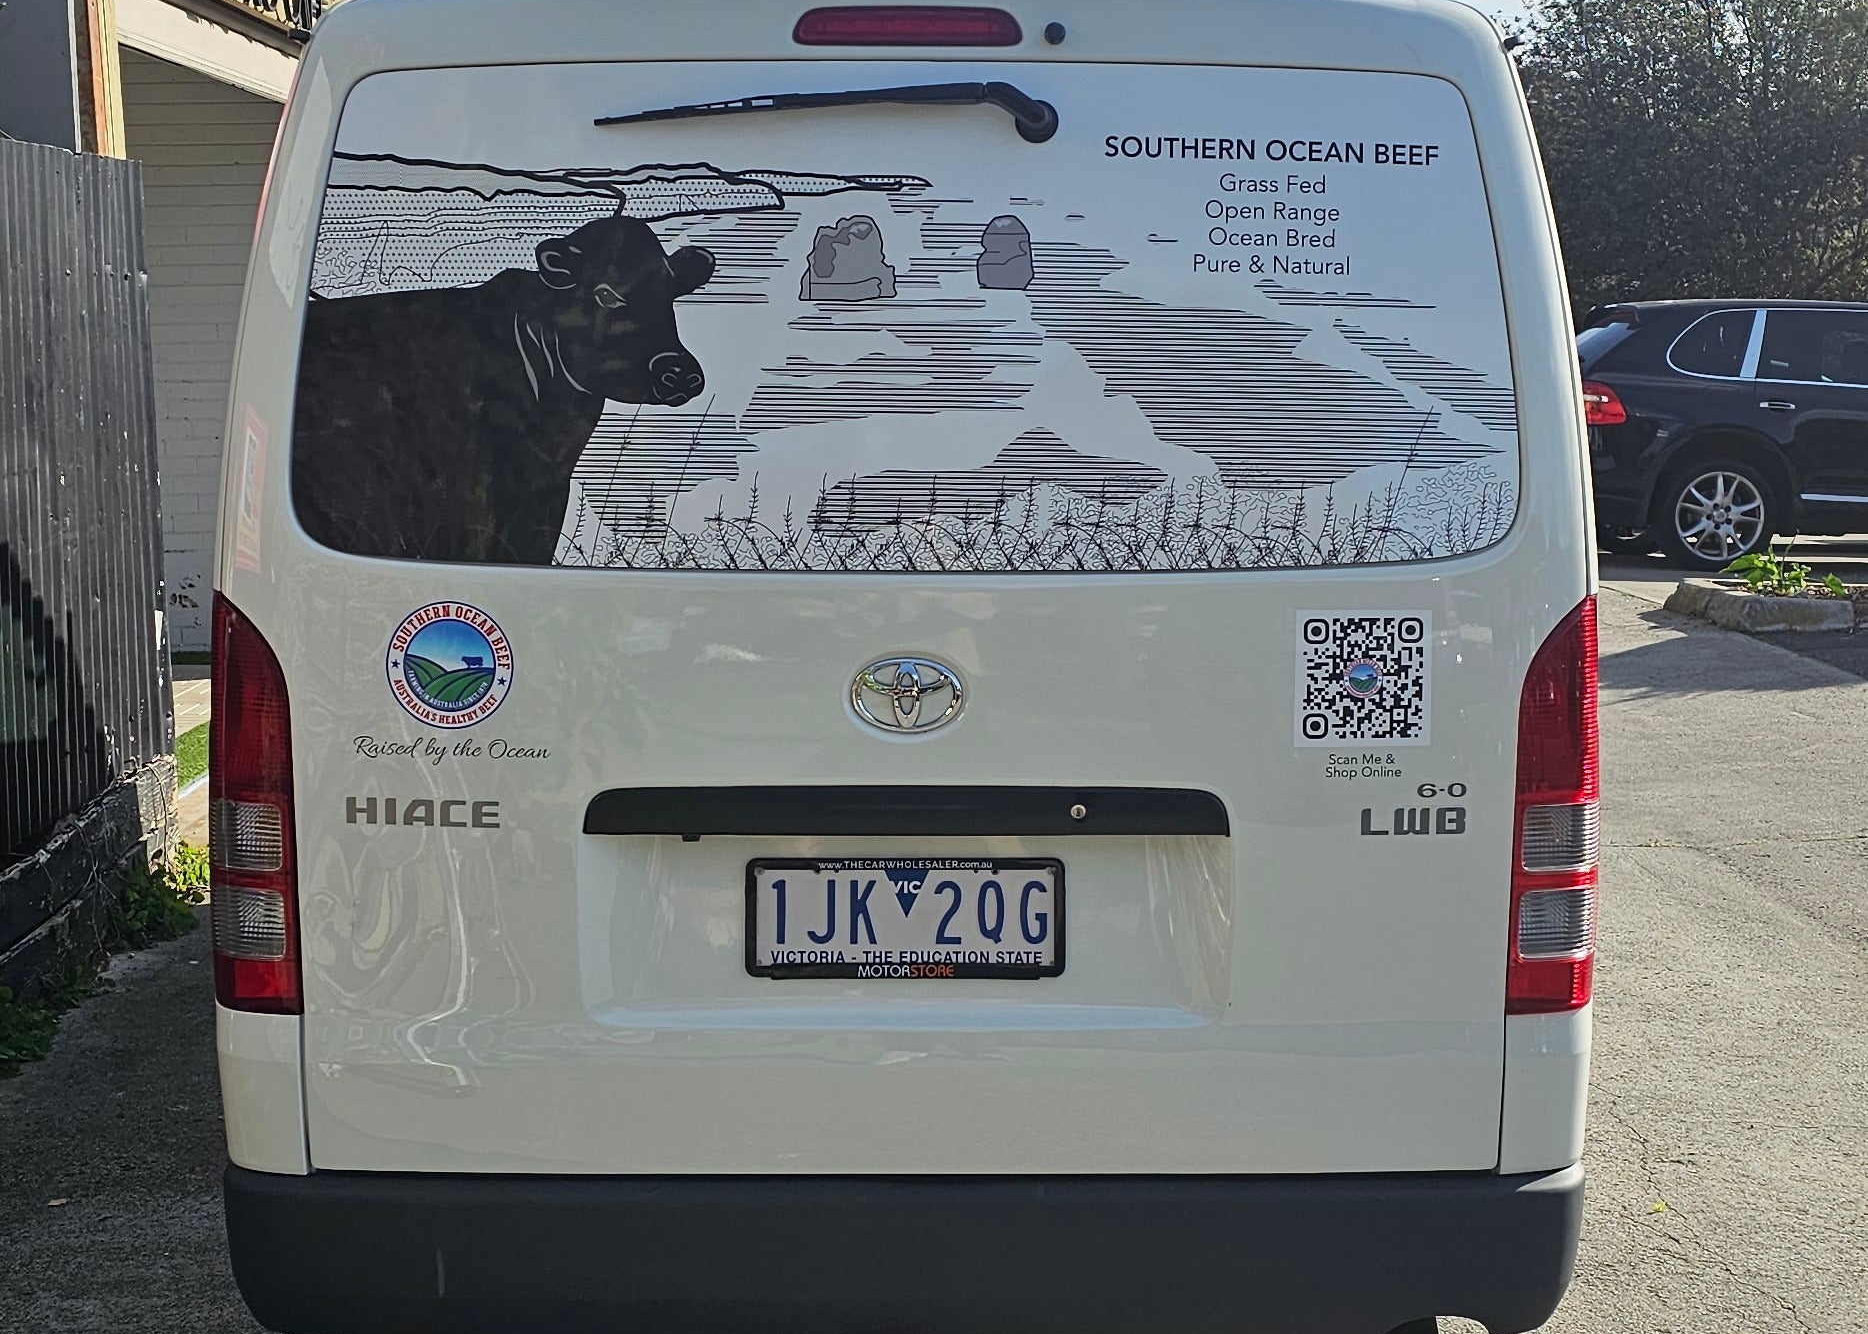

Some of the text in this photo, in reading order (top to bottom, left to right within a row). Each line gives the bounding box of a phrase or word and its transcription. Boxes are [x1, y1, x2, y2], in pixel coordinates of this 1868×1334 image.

[1104, 135, 1440, 166] SOUTHERN OCEAN BEEF
[1220, 173, 1326, 194] Grass Fed
[1205, 200, 1340, 226] Open Range
[1208, 227, 1335, 248] Ocean Bred
[1194, 254, 1350, 276] Pure & Natural
[393, 605, 510, 670] SOUTHERN OCEAN BEEF
[394, 680, 498, 724] AUSTRALIA'S HEALTHY BEEF
[430, 698, 462, 708] AUSTRALIA
[354, 736, 551, 766] Raised by the Ocean
[1328, 754, 1395, 764] Scan Me &
[1325, 766, 1402, 780] Shop Online
[346, 796, 500, 828] HIACE
[1360, 807, 1466, 836] LWB
[818, 860, 992, 869] www.THECARWHOLESALER.com.au
[890, 880, 922, 894] VIC
[772, 879, 1048, 944] 1JK 2QG
[770, 950, 846, 964] VICTORIA
[862, 950, 893, 964] THE
[900, 950, 990, 964] EDUCATION
[996, 951, 1042, 964] STATE
[857, 965, 955, 978] MOTORSTORE
